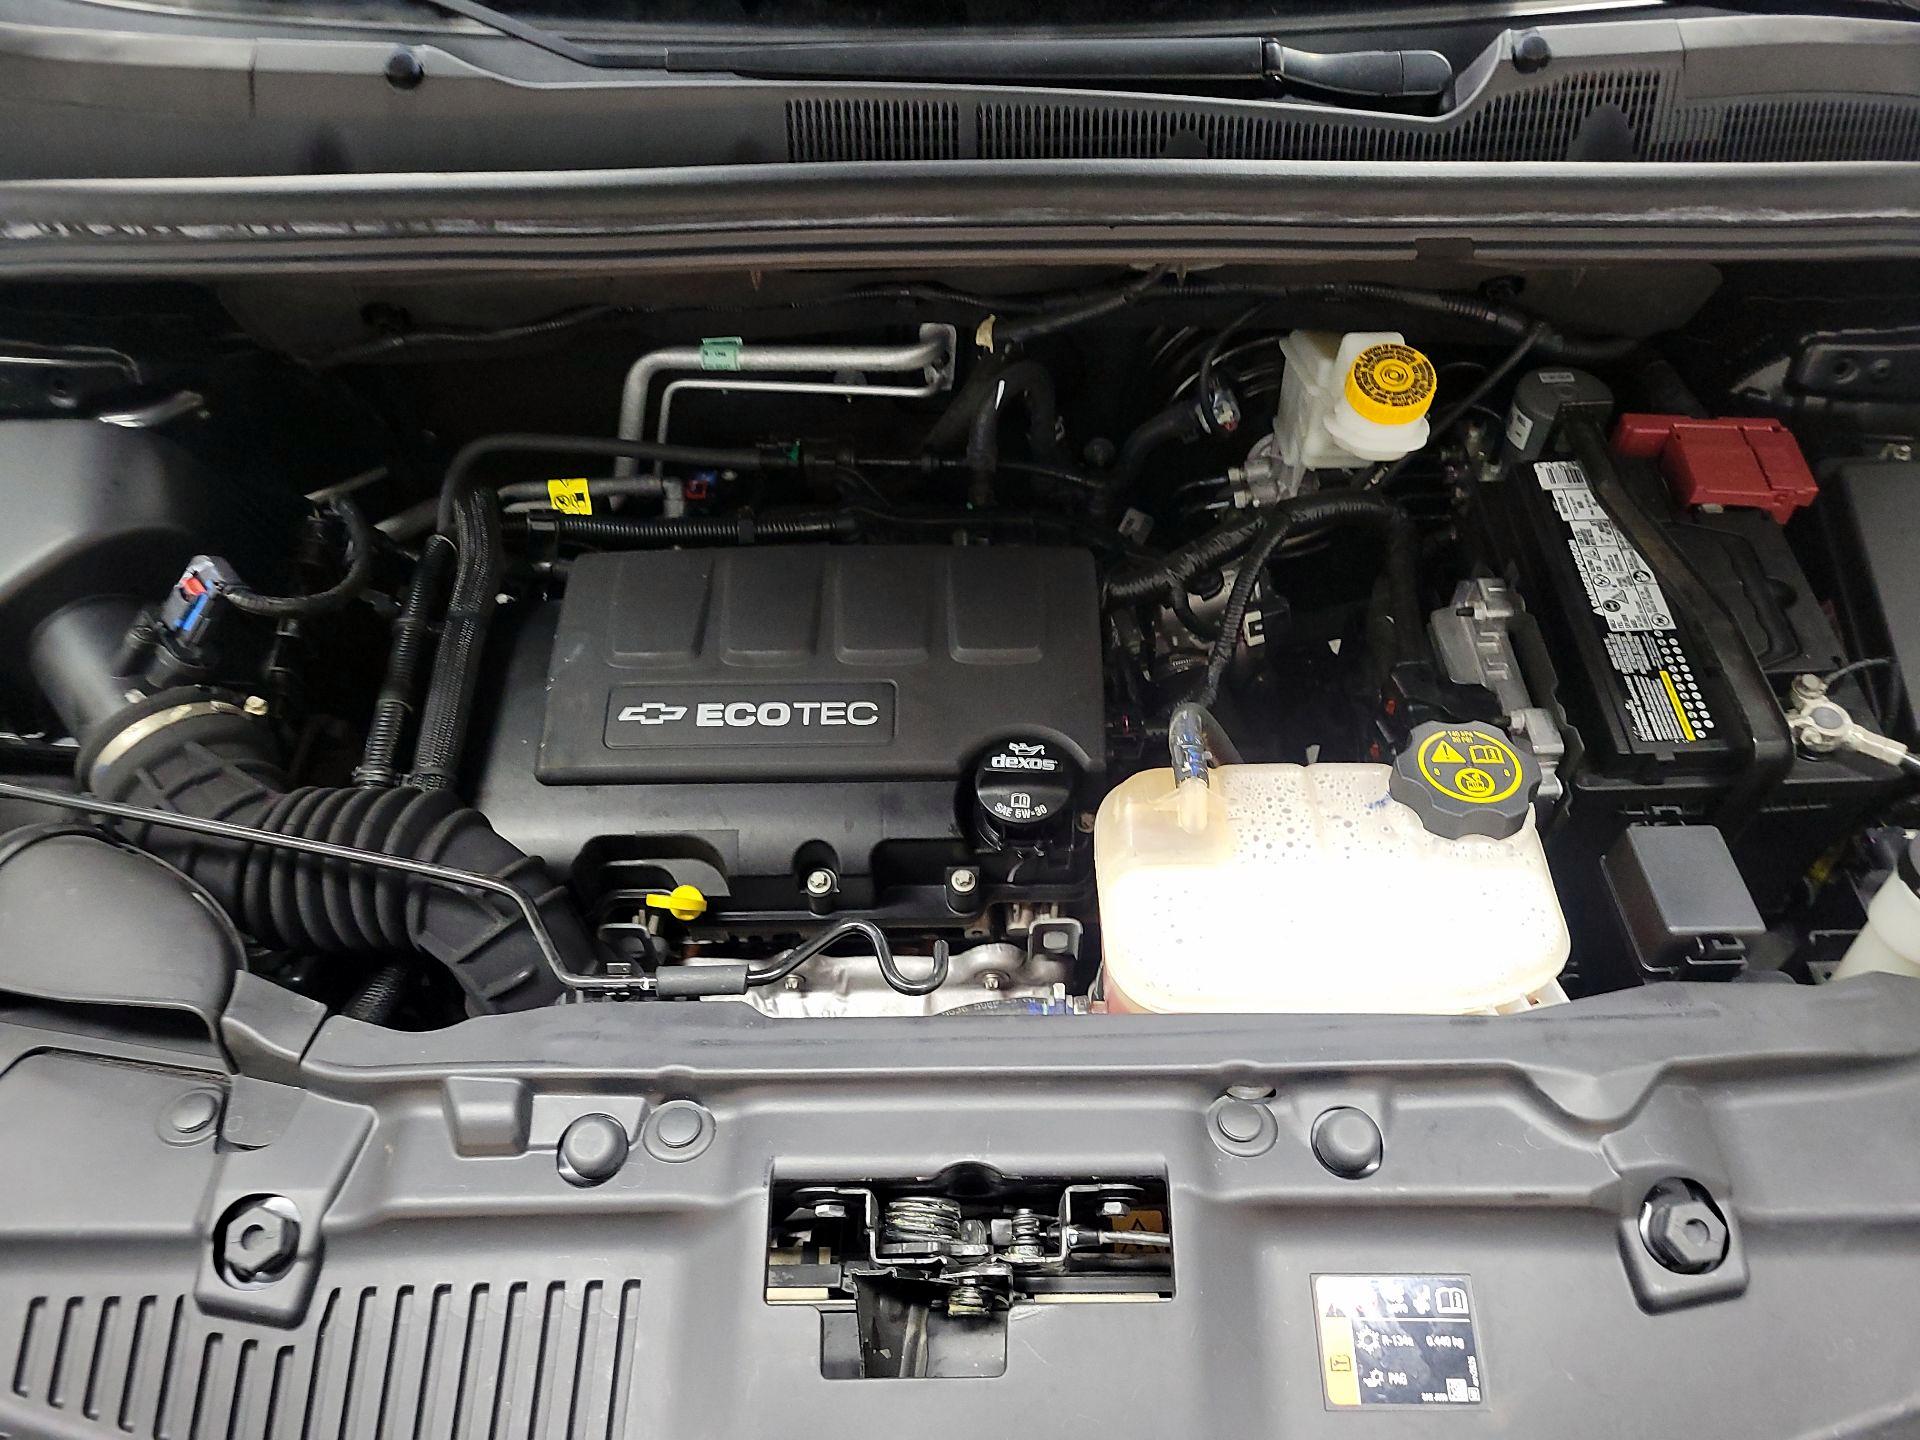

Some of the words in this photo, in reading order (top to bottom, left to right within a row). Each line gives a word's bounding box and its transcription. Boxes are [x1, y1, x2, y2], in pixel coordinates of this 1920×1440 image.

[696, 701, 879, 727] ECOTEC
[991, 753, 1057, 771] dexos
[994, 802, 1013, 818] SAE
[1015, 804, 1048, 819] 5W-30
